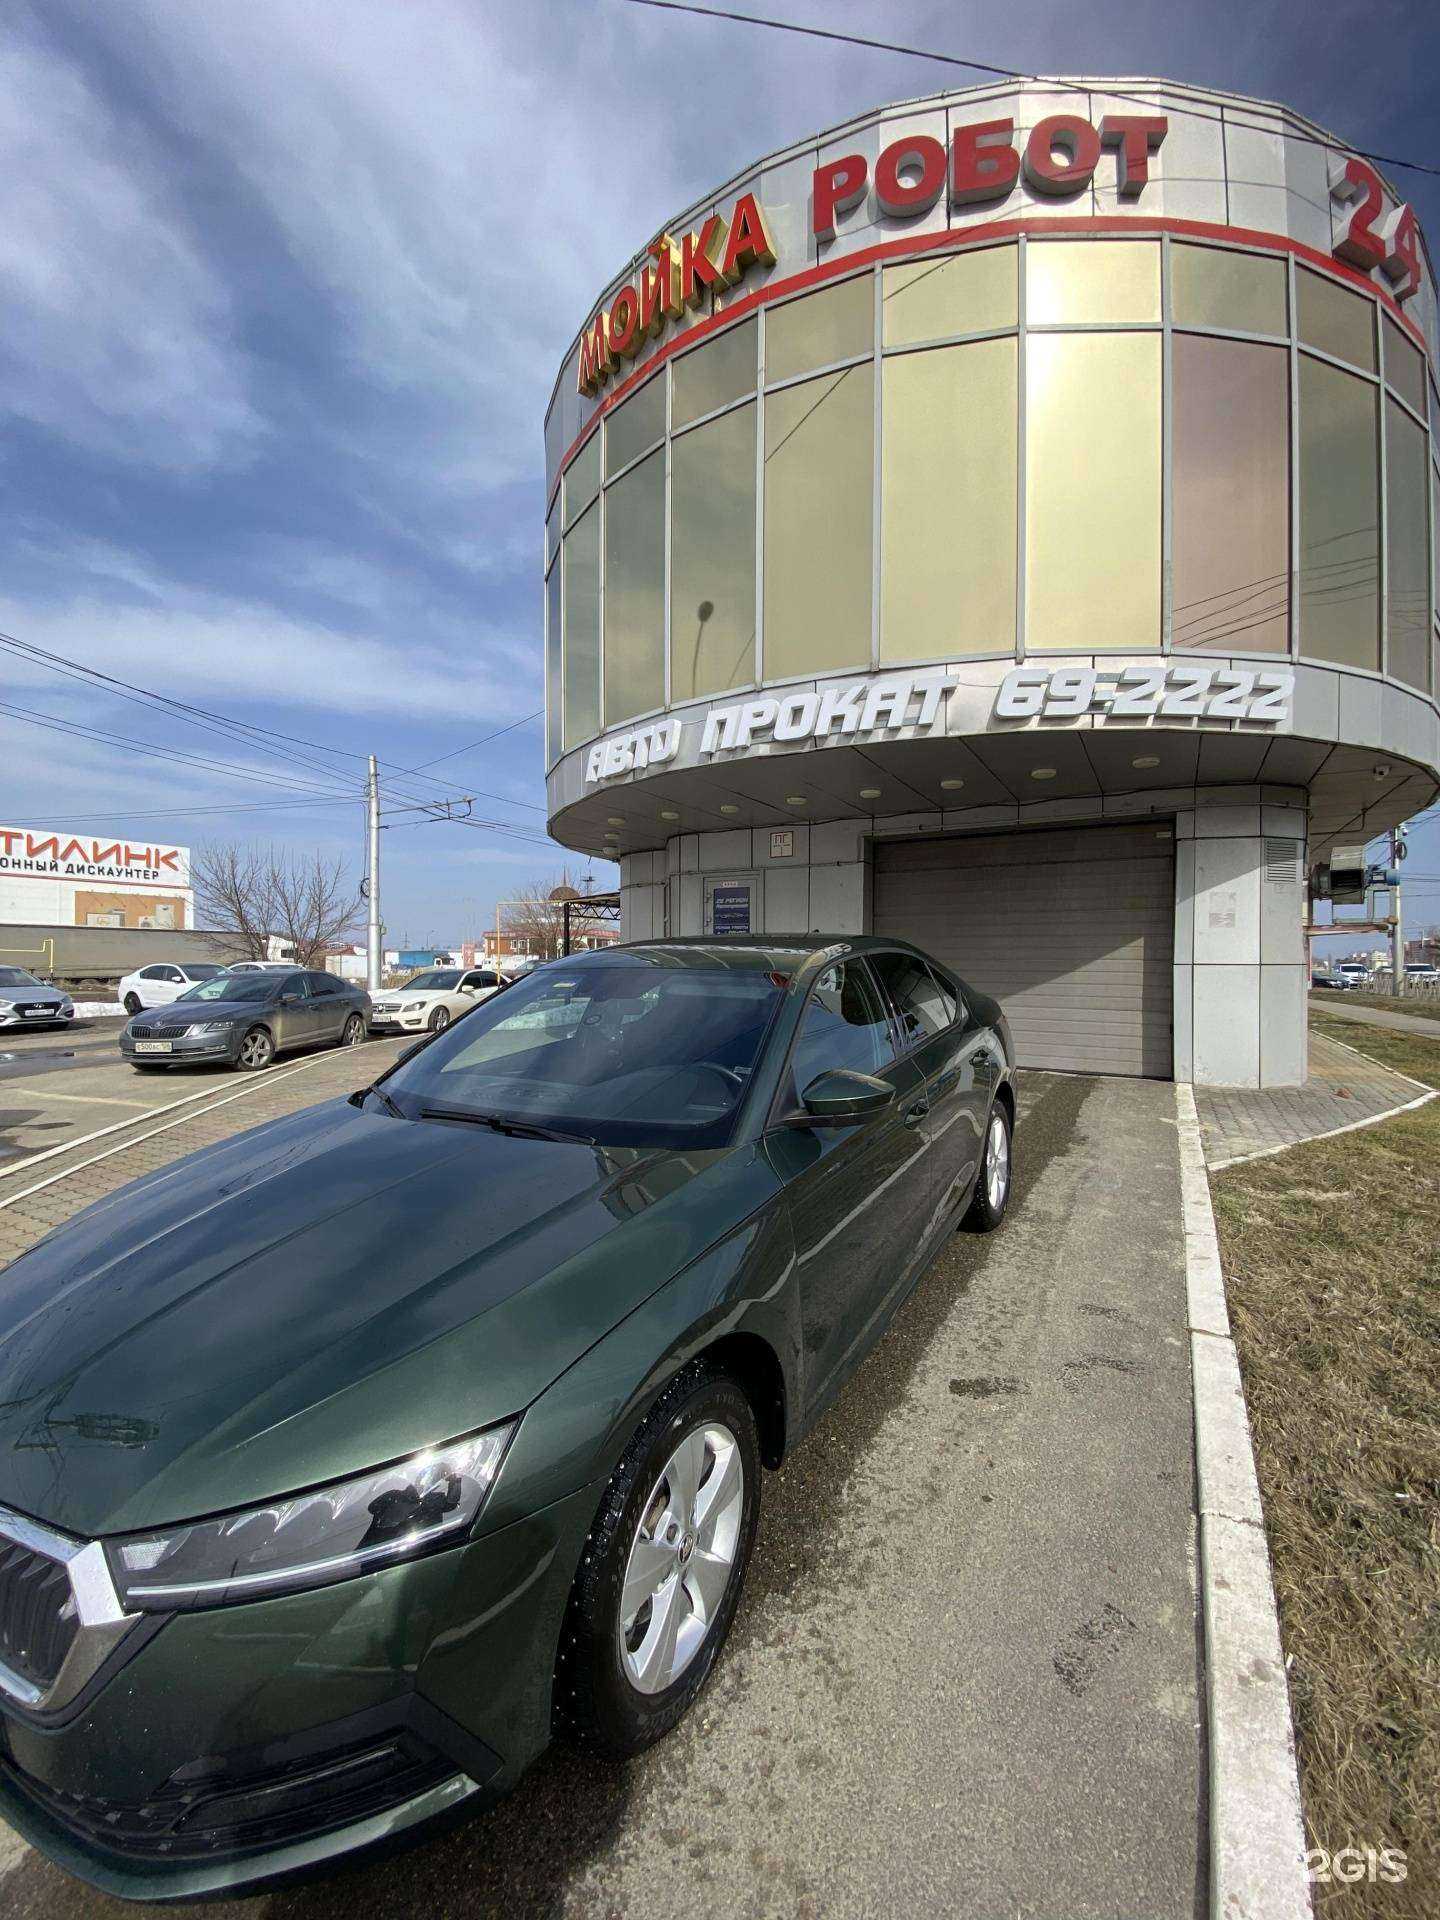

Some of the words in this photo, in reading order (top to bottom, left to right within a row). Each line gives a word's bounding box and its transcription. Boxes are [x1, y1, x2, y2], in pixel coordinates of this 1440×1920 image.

[577, 193, 776, 398] МОЙКА
[813, 115, 1168, 244] РОБОТ
[1332, 158, 1421, 300] 24
[585, 718, 682, 783] АВТО
[700, 681, 958, 754] ПРОКАТ
[995, 666, 1295, 722] 69-2222
[0, 831, 179, 871] ТИЛИНК
[0, 857, 59, 872] ОННЫЙ
[65, 863, 160, 880] ДИСКАУНТЕР
